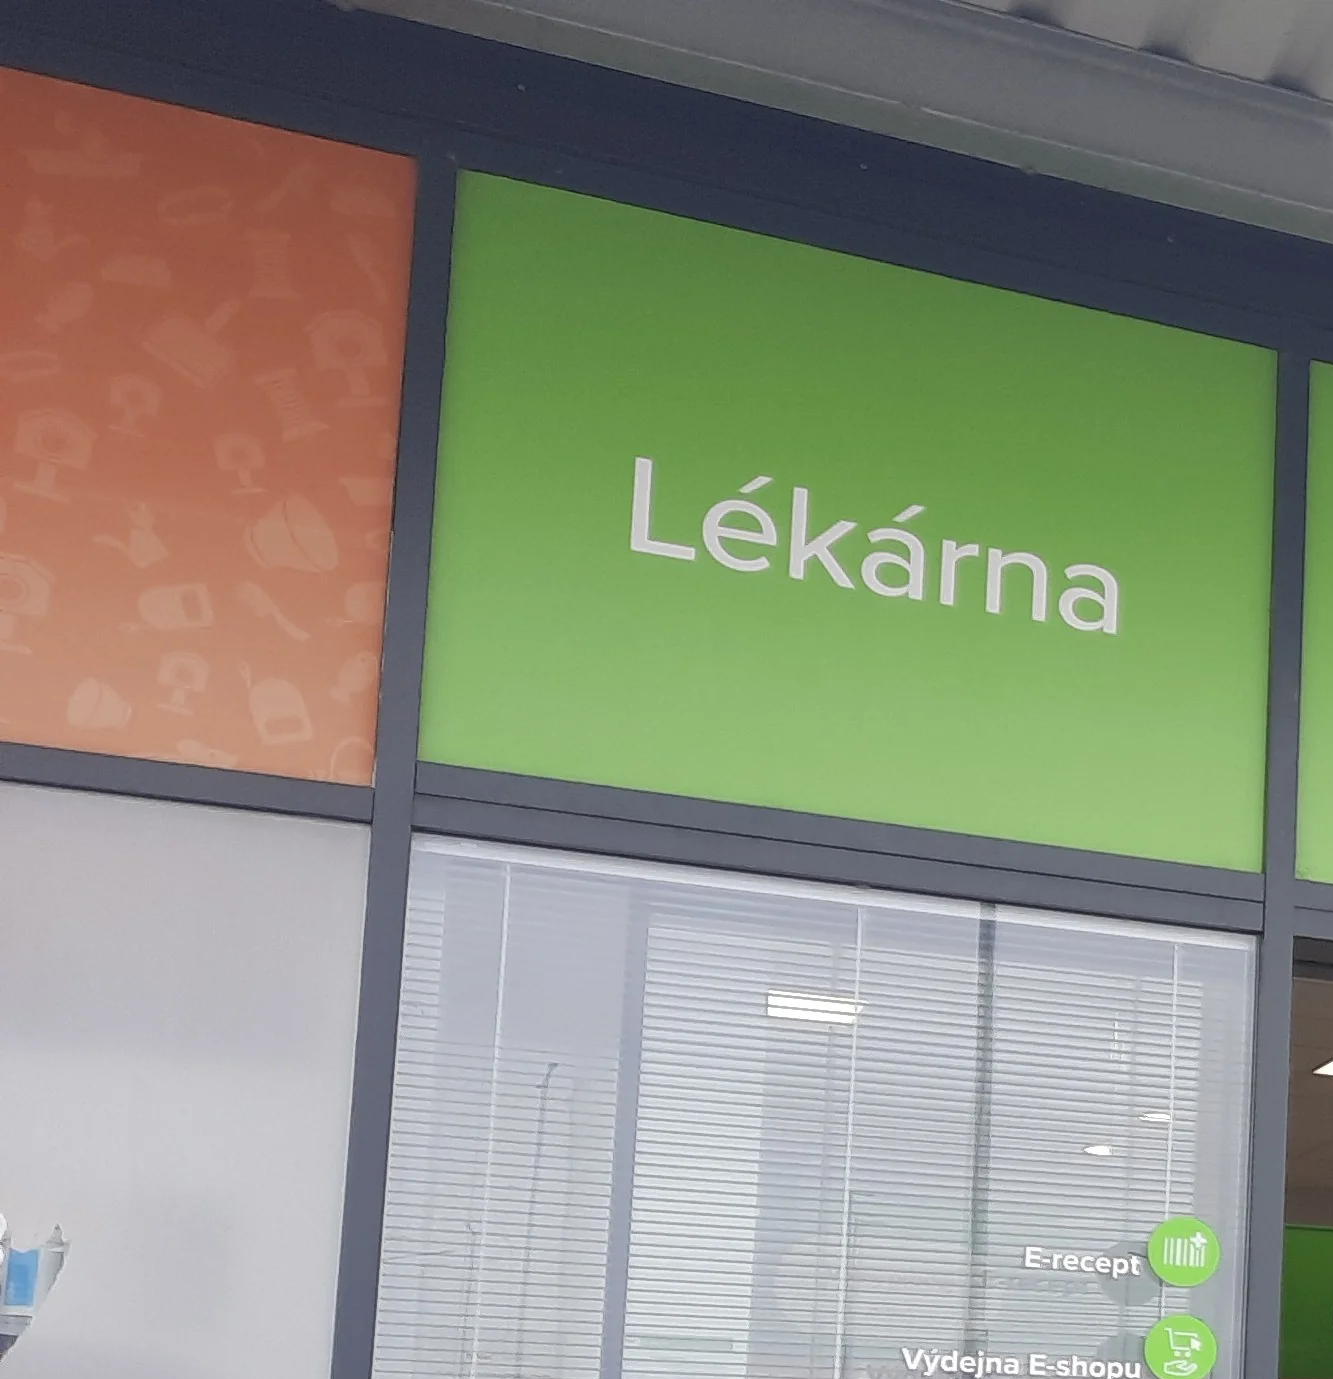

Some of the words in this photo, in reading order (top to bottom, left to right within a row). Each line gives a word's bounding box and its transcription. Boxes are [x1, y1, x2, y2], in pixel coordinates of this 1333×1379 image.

[629, 456, 1119, 636] Lékárna
[1023, 1246, 1142, 1278] E-recept
[901, 1346, 1020, 1378] Výdejna
